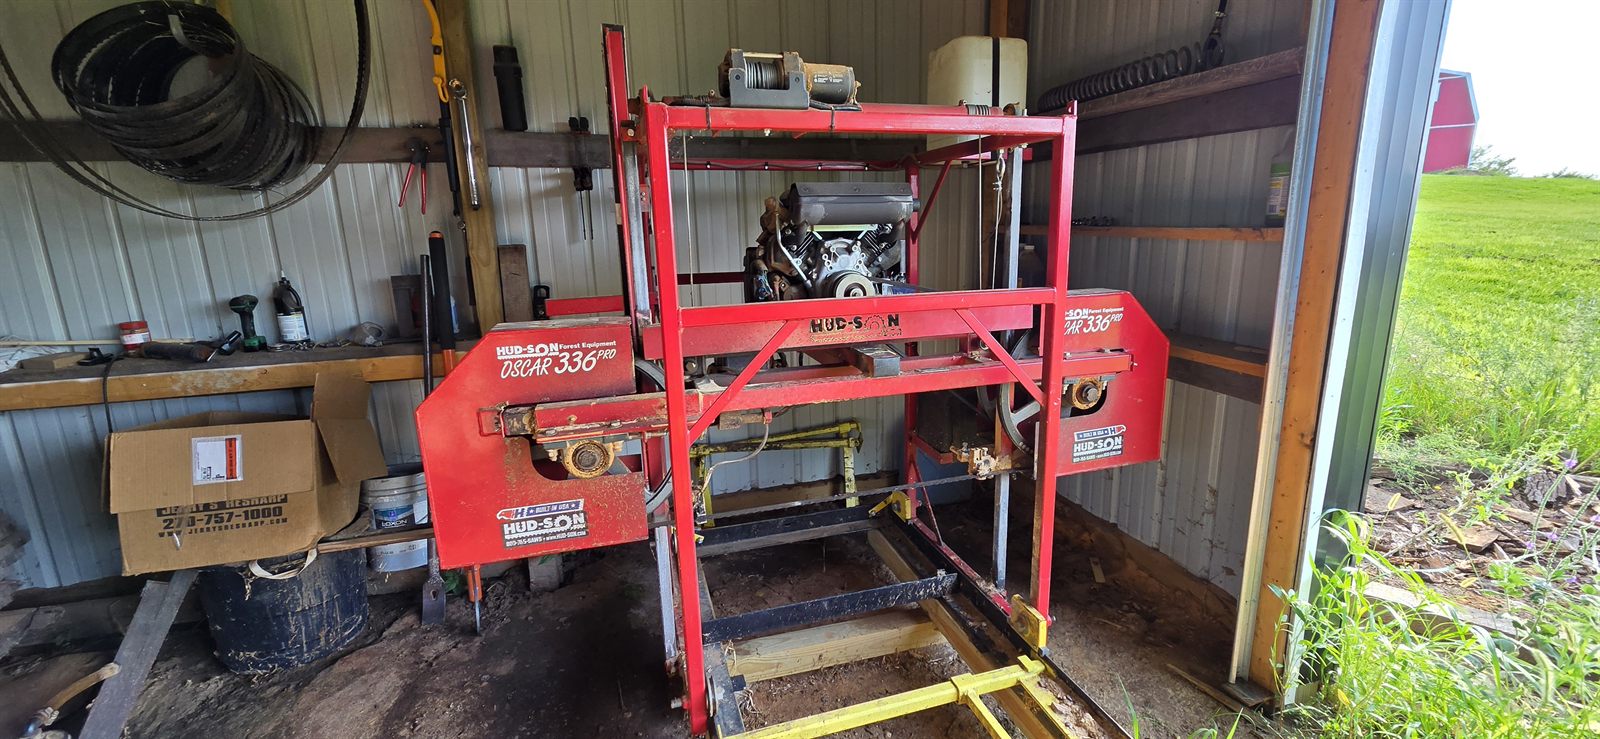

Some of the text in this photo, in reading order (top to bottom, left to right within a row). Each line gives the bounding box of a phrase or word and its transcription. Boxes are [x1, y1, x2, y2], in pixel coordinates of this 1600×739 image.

[810, 314, 899, 333] HUD-SON
[1083, 313, 1111, 333] 336
[496, 343, 559, 358] HUD-SON
[582, 340, 617, 349] Equipment
[500, 349, 617, 379] OSCAR 336 PRO
[1073, 436, 1122, 452] HUD-SON
[162, 502, 218, 515] JERYS
[162, 506, 283, 530] 270-757-1000
[158, 517, 288, 537] WWWJERRYSRESHARP.COM
[503, 513, 585, 534] HUD-SON
